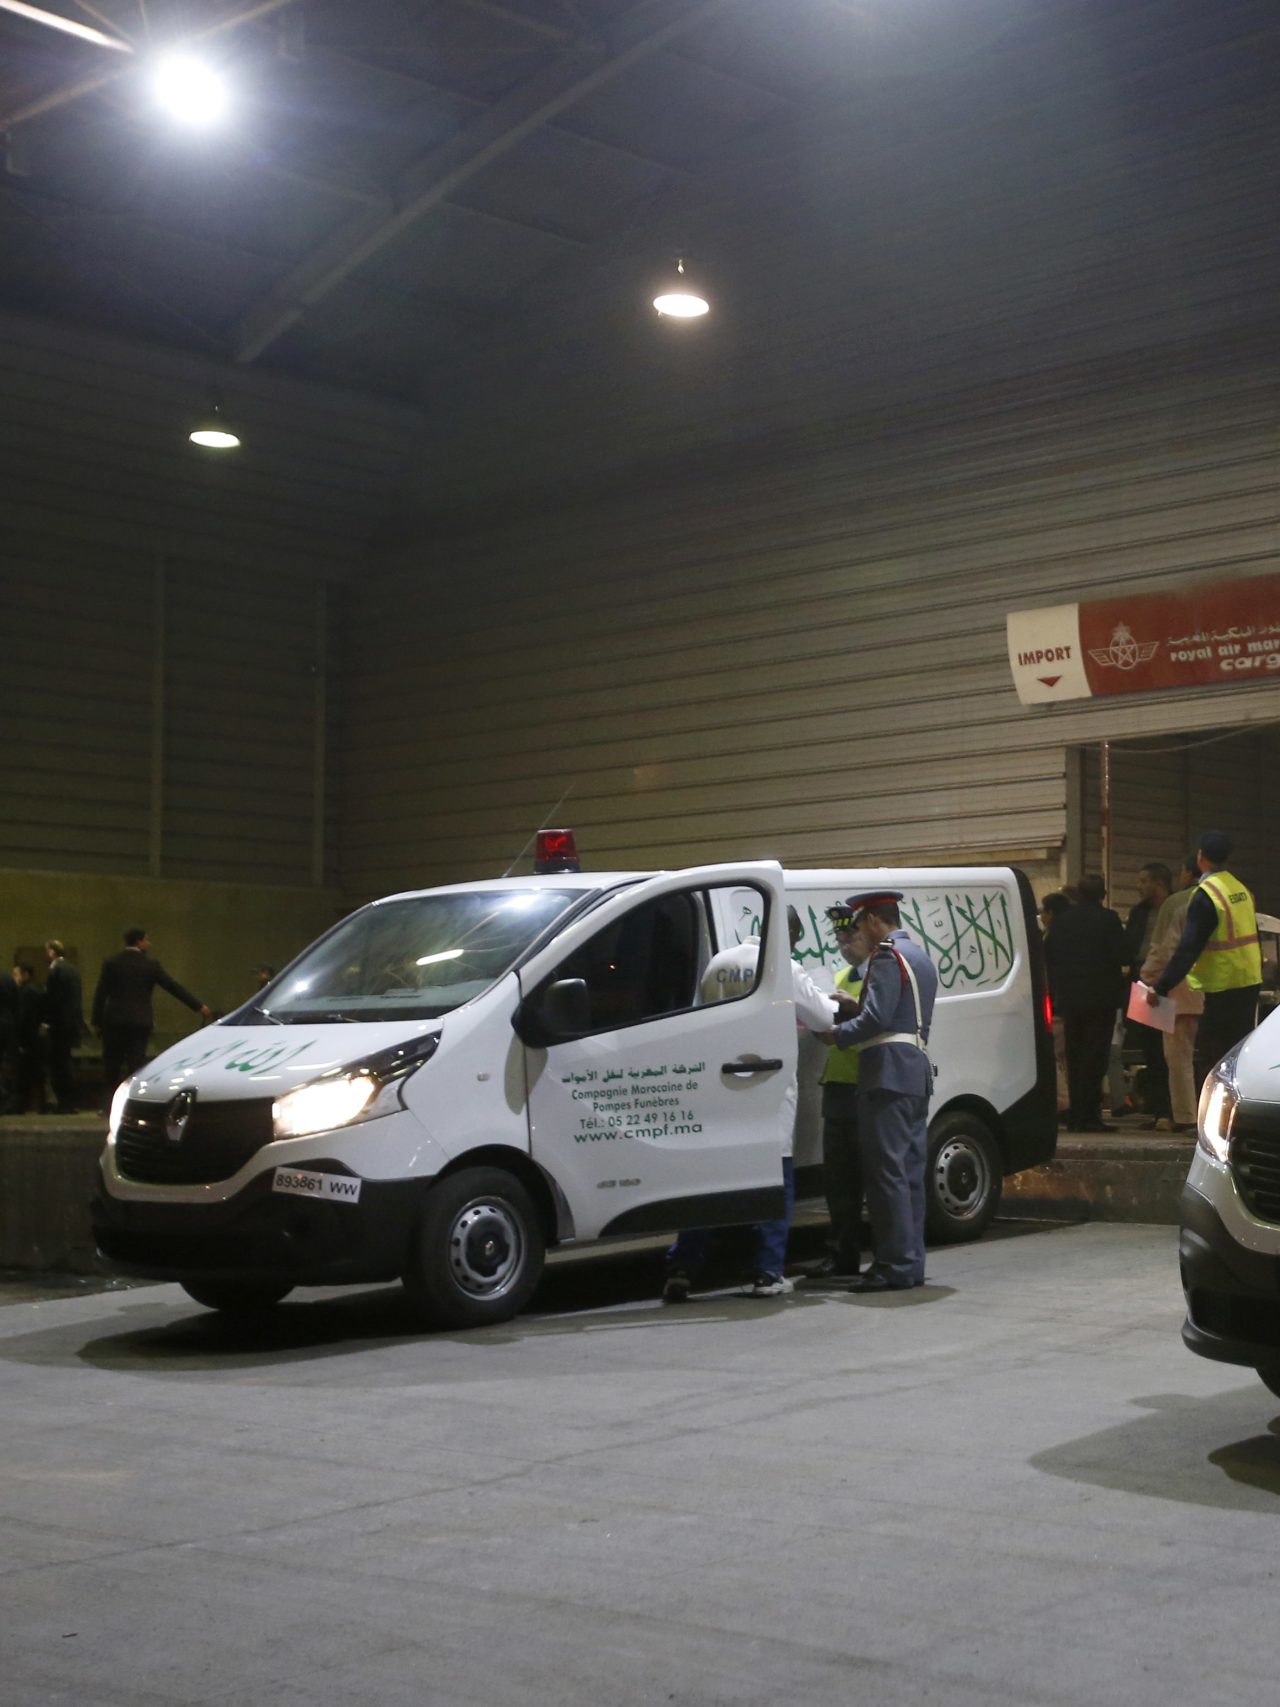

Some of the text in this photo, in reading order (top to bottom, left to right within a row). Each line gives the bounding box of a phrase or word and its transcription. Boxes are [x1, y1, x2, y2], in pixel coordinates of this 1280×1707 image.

[1017, 646, 1072, 666] IMPORT
[1170, 647, 1212, 663] royal
[1218, 643, 1242, 656] air
[571, 1079, 699, 1100] Compagnie Marocaine de
[593, 1096, 680, 1113] Pompes Funèbres
[608, 1116, 623, 1127] 05
[626, 1114, 640, 1125] 22
[644, 1112, 658, 1124] 49
[663, 1111, 677, 1122] 16
[680, 1110, 694, 1121] 16
[573, 1123, 703, 1144] www.cmpf.ma
[275, 1174, 358, 1196] 893861 WW
